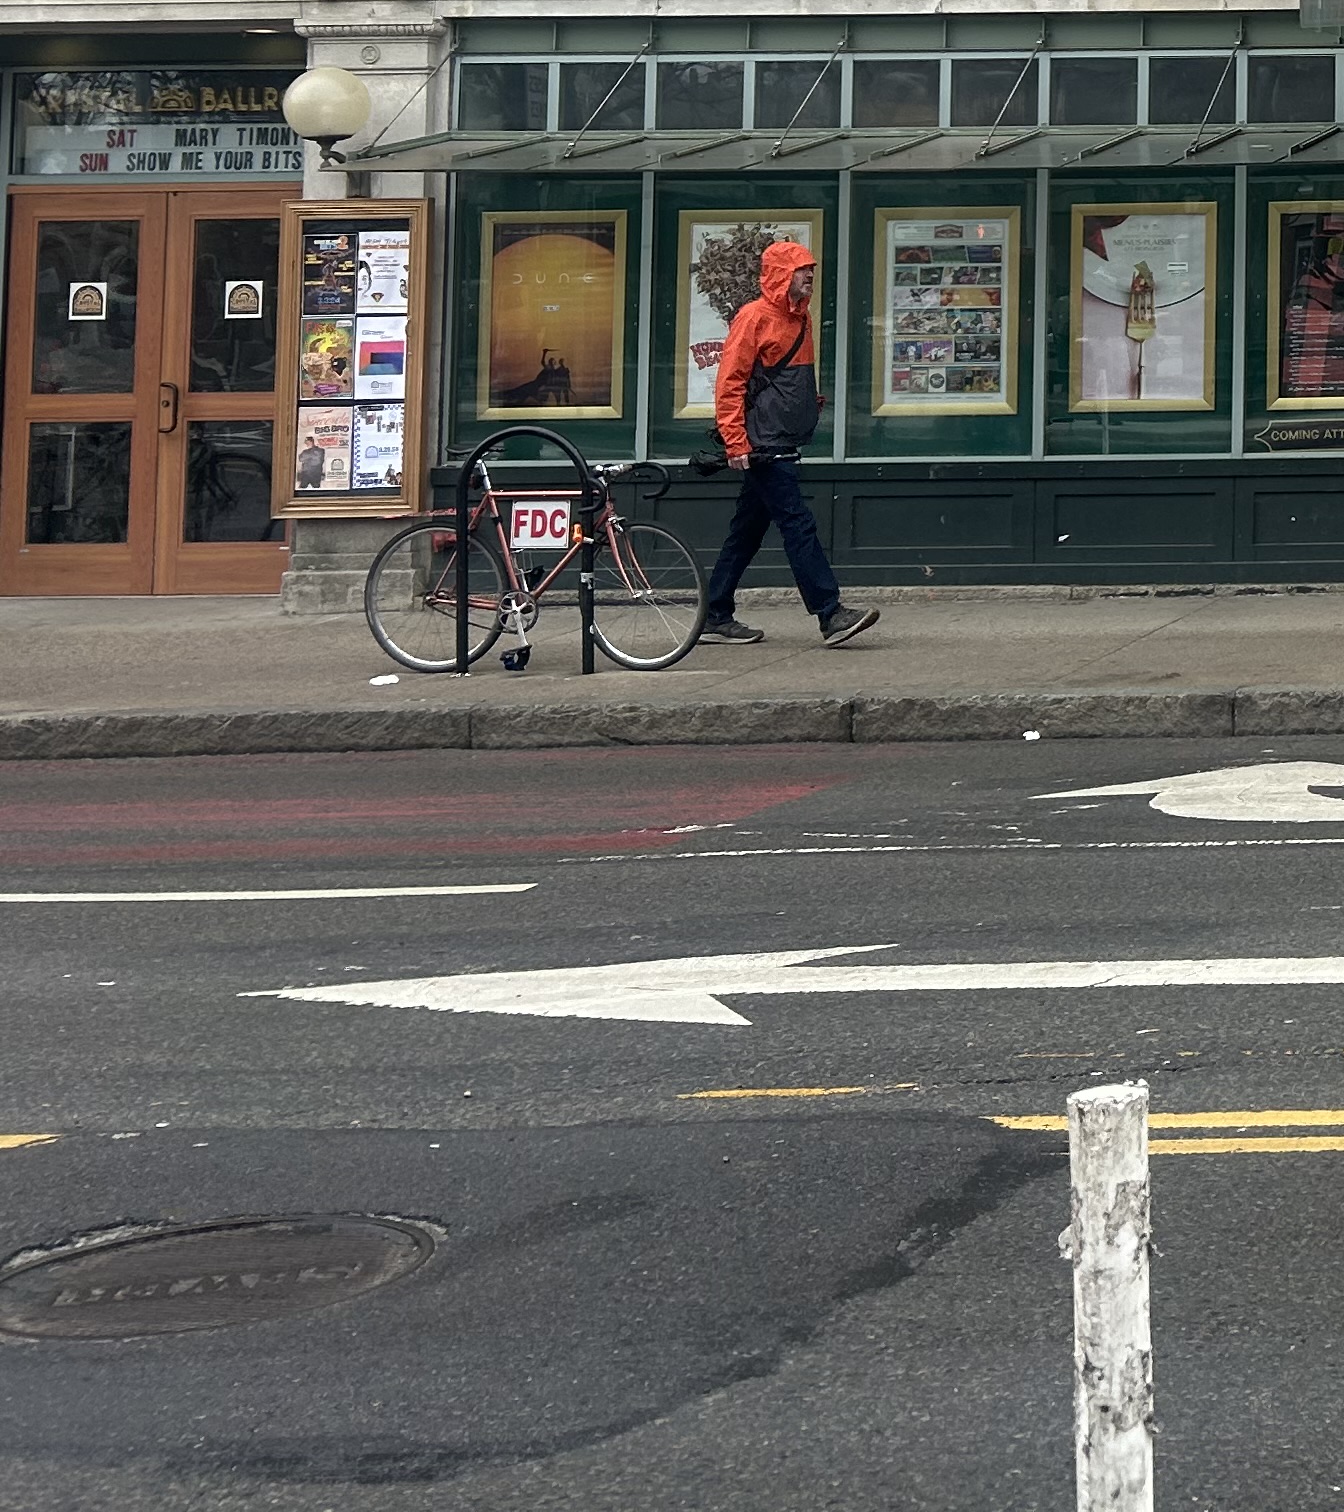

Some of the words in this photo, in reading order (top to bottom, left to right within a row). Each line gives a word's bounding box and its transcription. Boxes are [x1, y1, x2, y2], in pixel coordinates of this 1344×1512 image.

[106, 128, 138, 148] SAT
[175, 127, 220, 147] MARY
[236, 127, 300, 147] TIMONY
[80, 153, 109, 172] SUN
[126, 152, 172, 172] SHOW
[181, 152, 203, 171] ME
[214, 151, 254, 171] YOUR
[262, 151, 303, 170] BITS
[513, 272, 595, 285] DUNE
[1271, 429, 1320, 441] COMING
[513, 509, 567, 539] FDC
